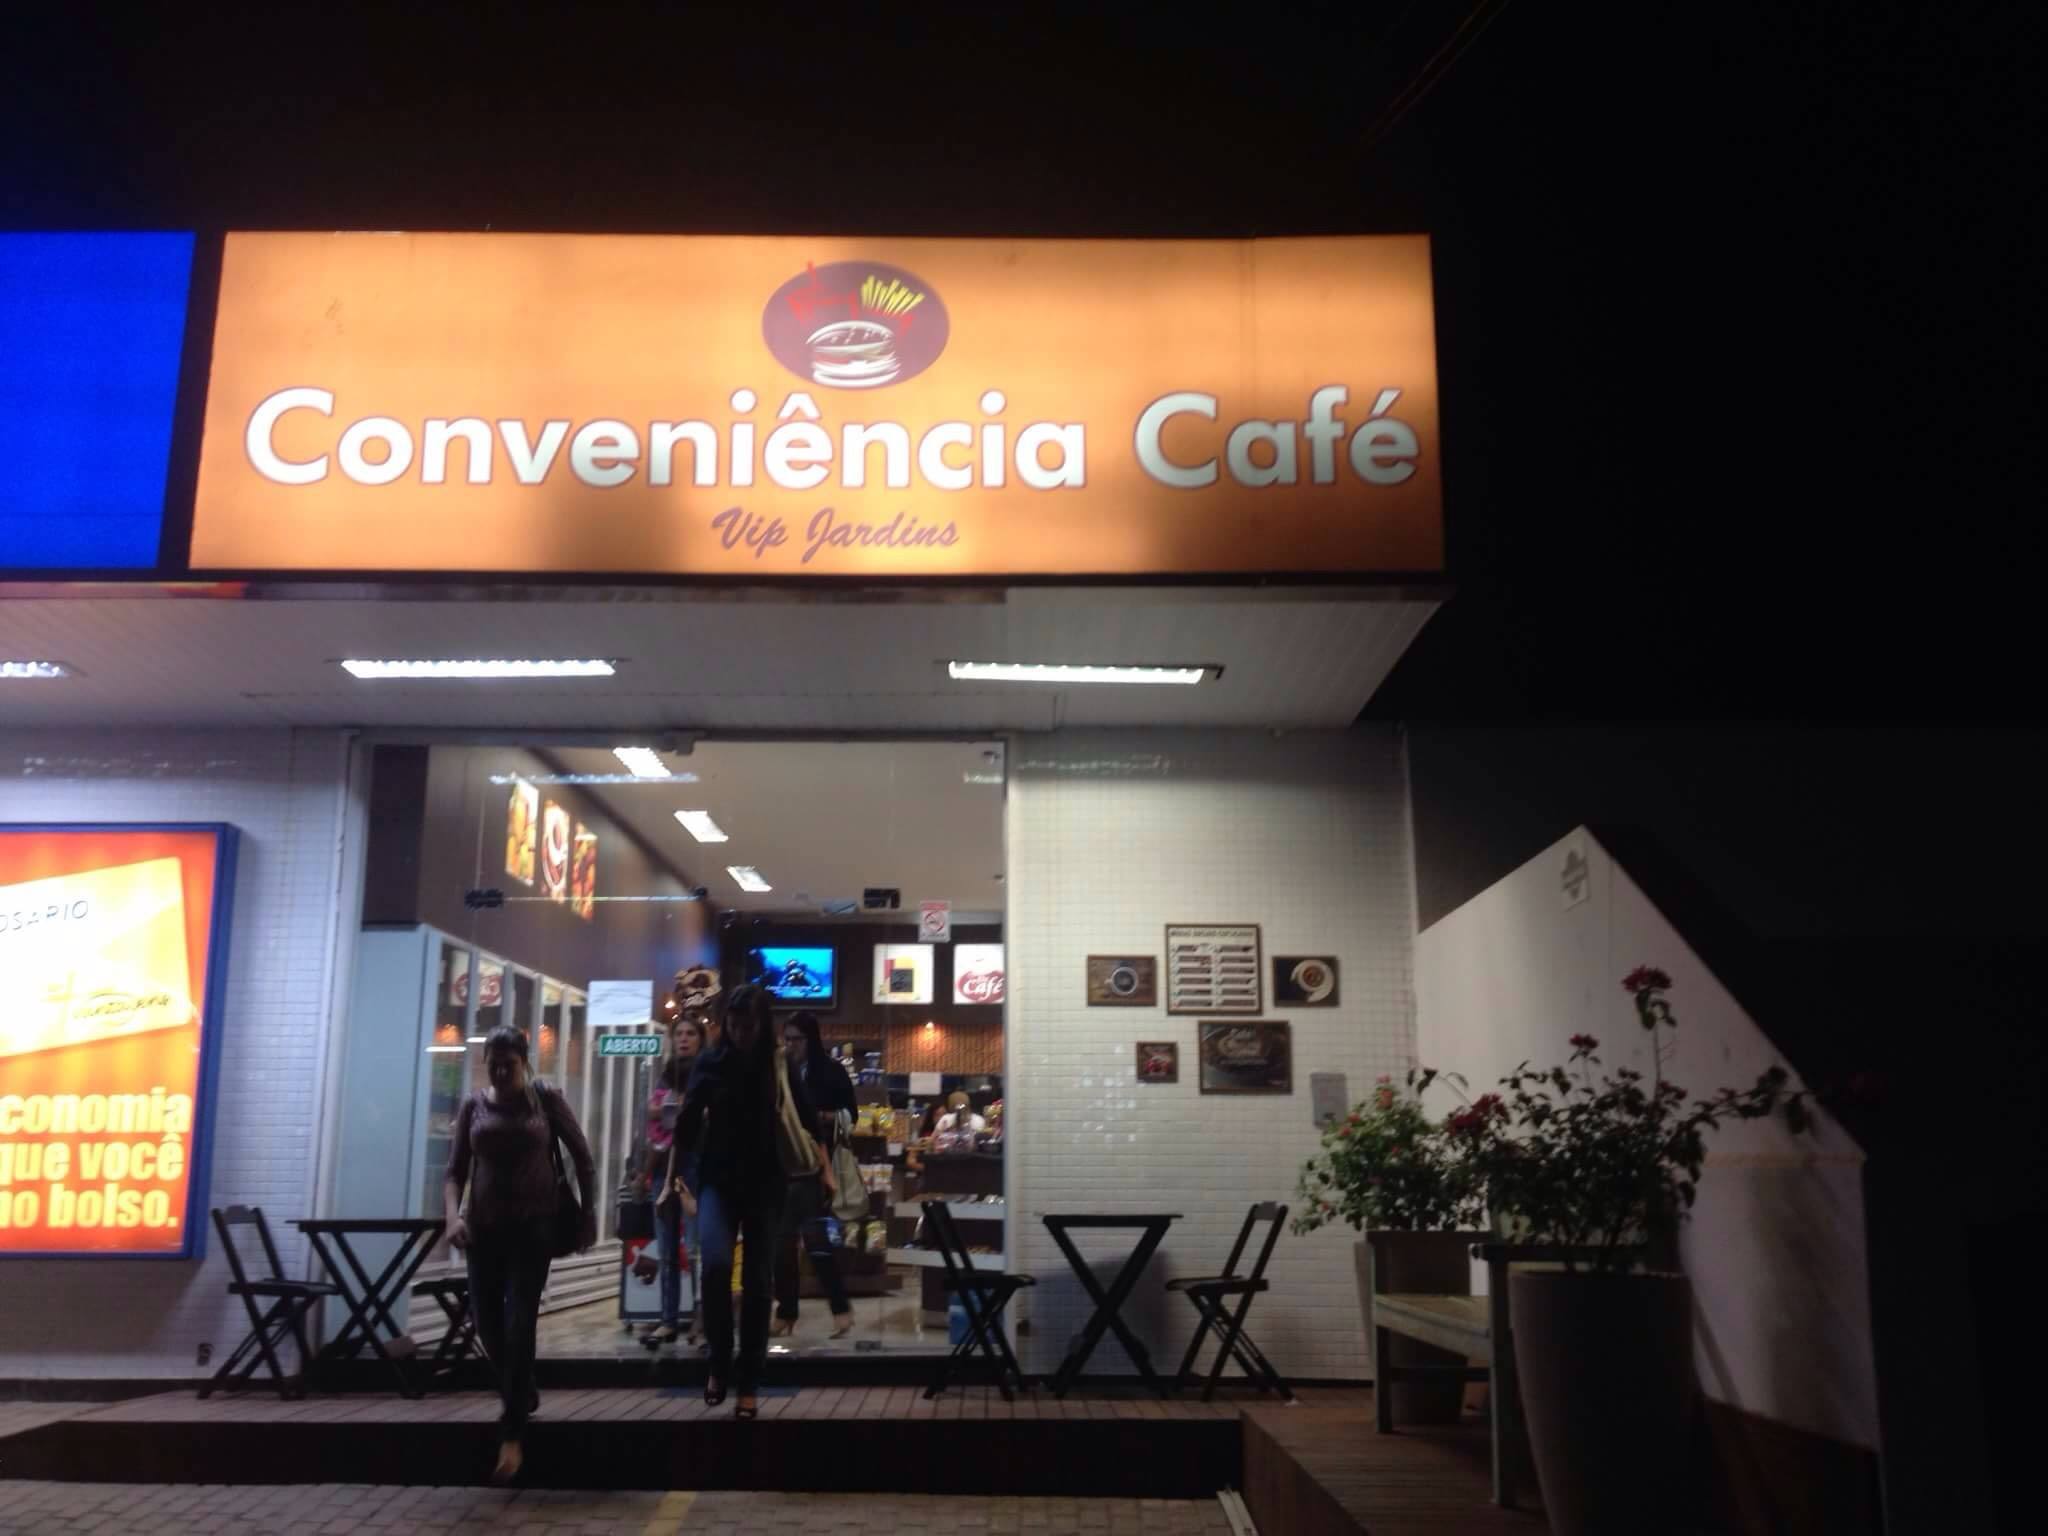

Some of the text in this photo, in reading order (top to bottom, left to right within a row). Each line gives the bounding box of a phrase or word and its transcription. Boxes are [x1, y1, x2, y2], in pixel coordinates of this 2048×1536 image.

[245, 385, 1420, 490] Conveniência Café
[711, 506, 961, 564] Vip Jardins
[603, 1038, 658, 1053] ABERTO
[79, 1132, 184, 1181] você
[48, 1183, 179, 1228] bolso.
